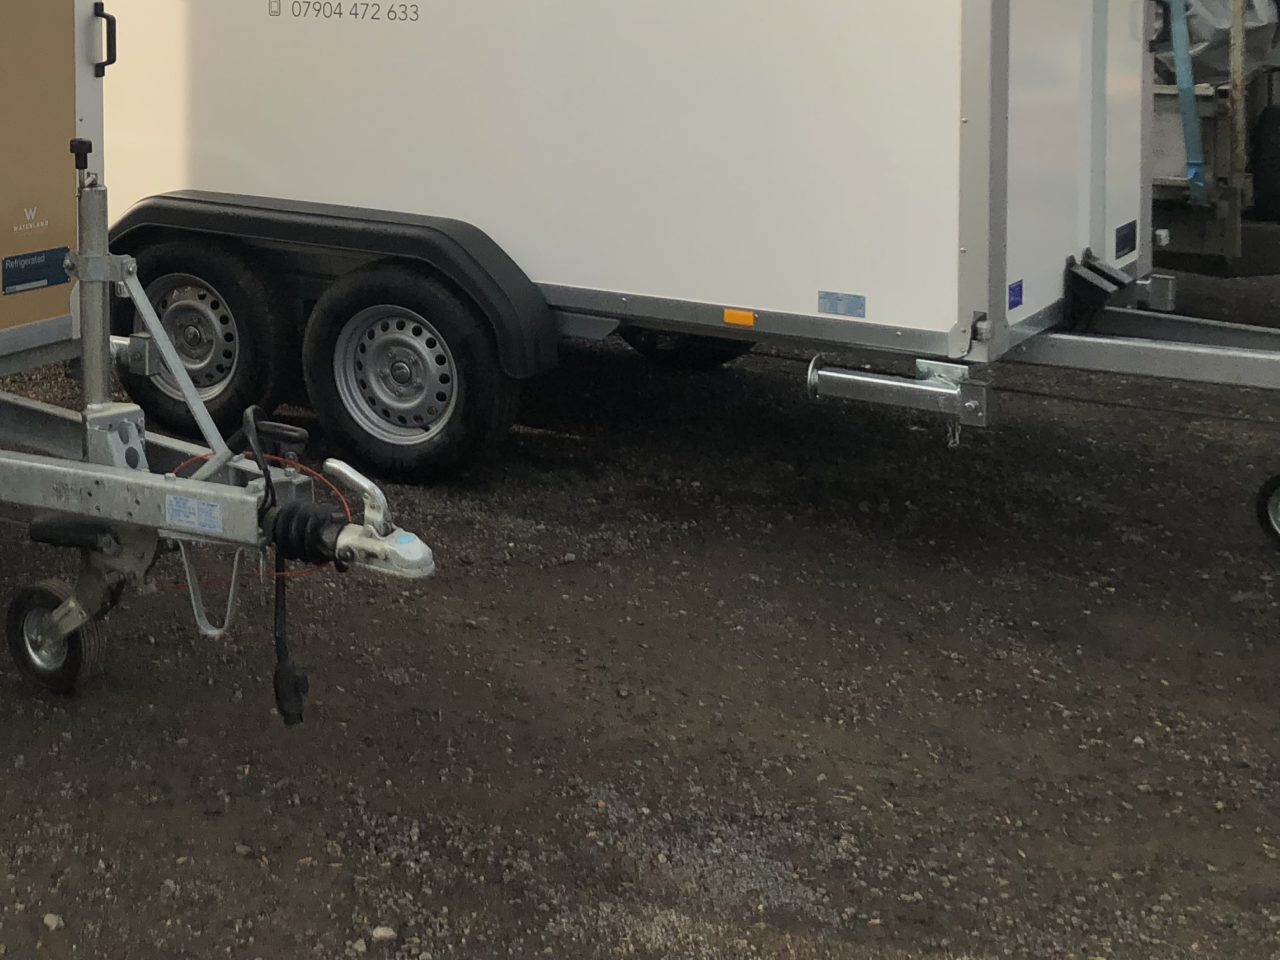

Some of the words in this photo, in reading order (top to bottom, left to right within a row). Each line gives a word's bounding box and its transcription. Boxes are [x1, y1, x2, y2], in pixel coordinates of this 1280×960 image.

[290, 0, 344, 19] 07904
[348, 2, 381, 20] 472
[386, 3, 420, 22] 633
[5, 253, 46, 270] Refrigerated
